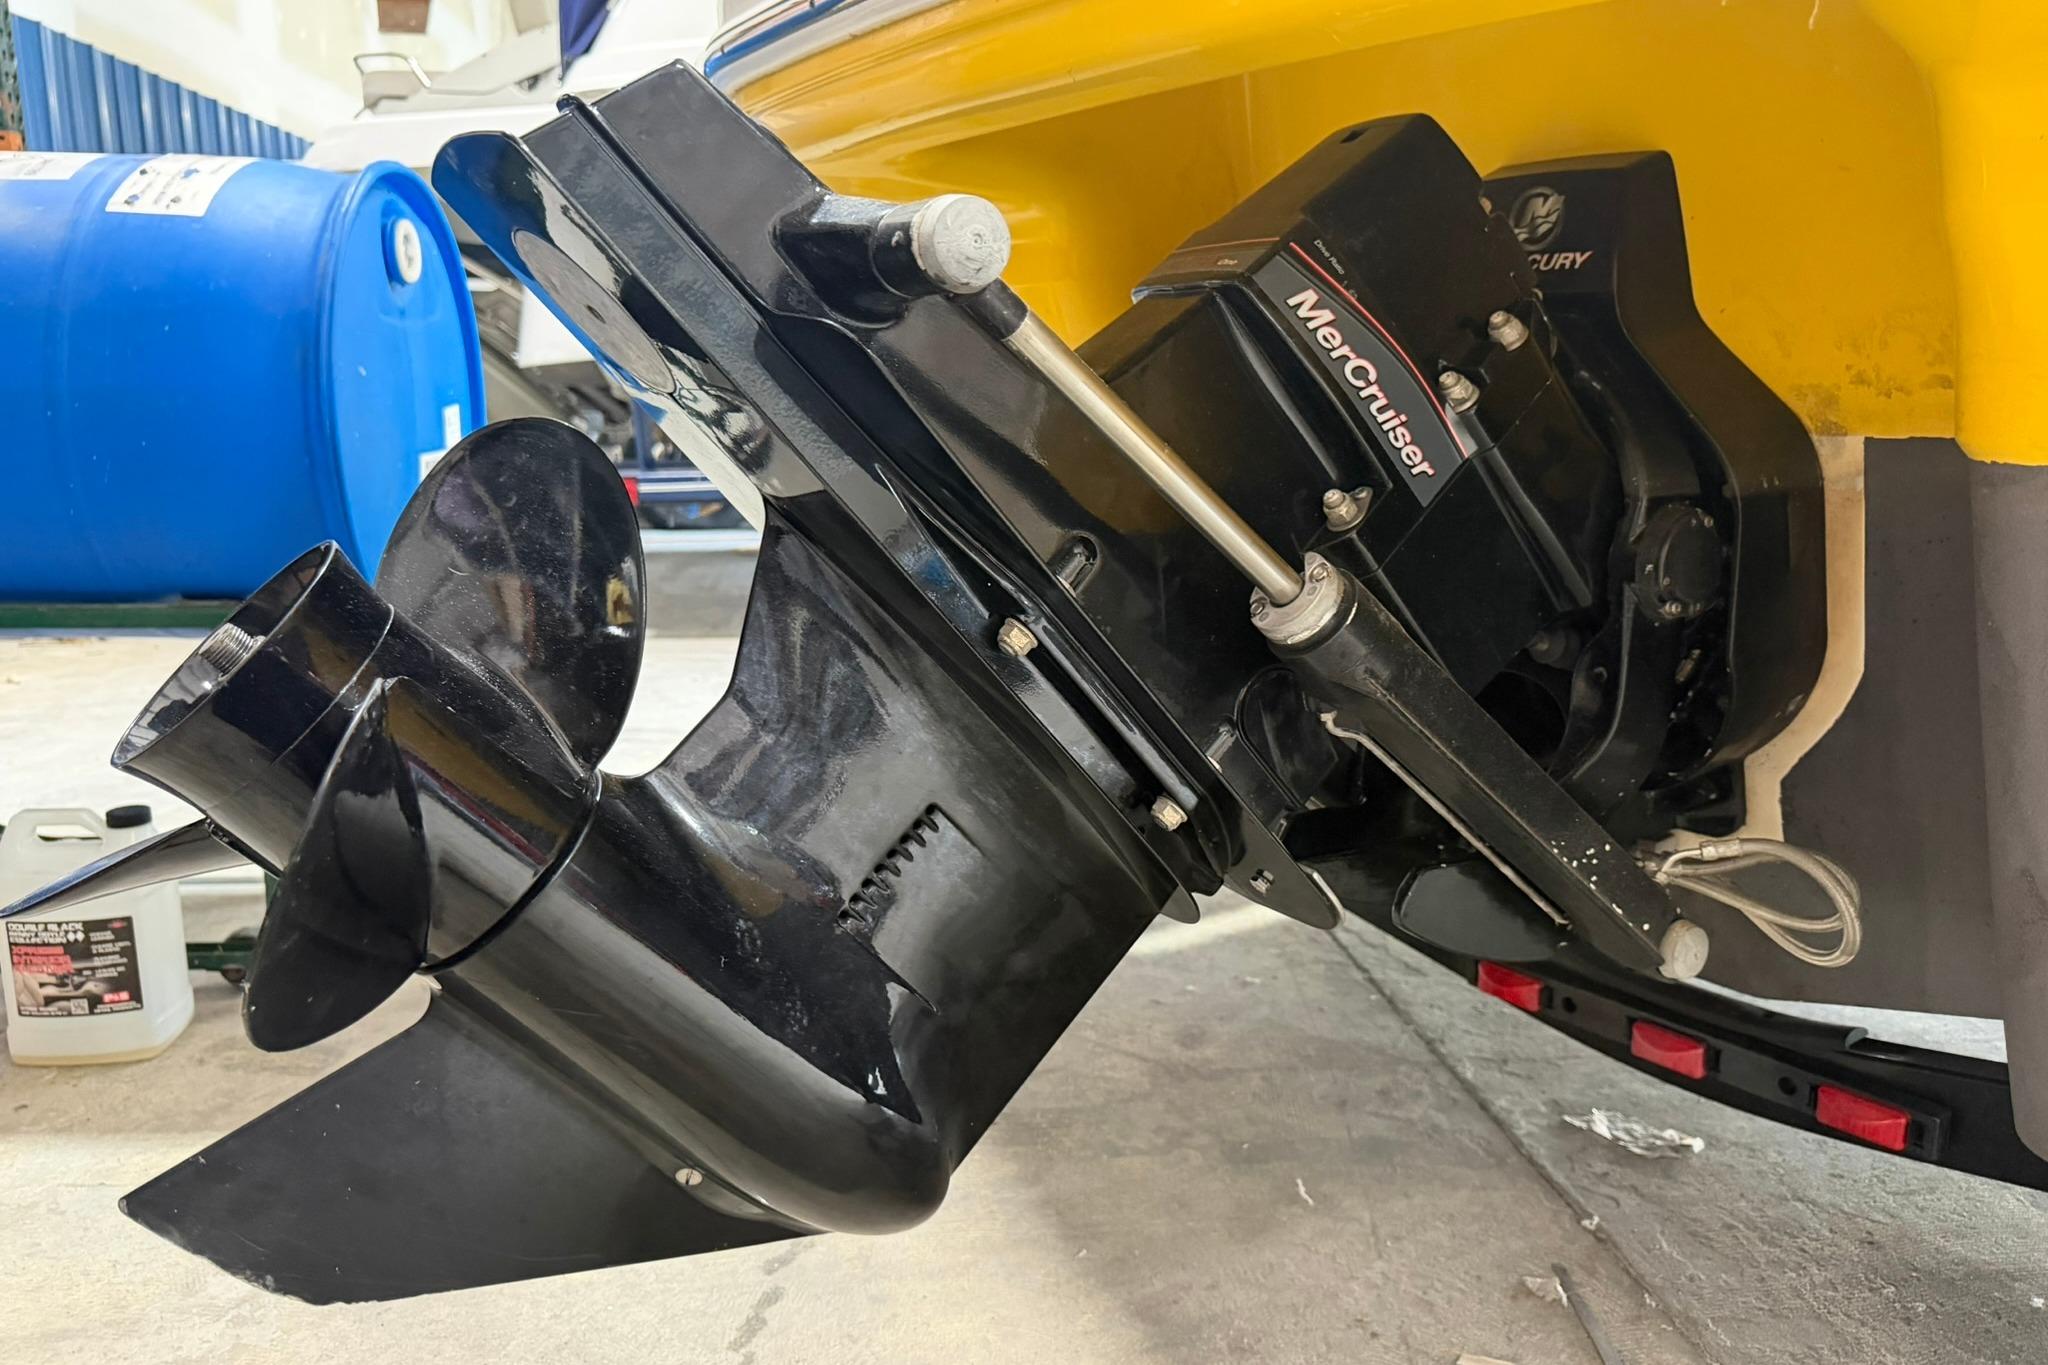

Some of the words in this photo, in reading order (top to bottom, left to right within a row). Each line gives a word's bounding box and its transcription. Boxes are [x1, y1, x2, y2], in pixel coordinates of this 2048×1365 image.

[1527, 250, 1594, 271] CURY
[1286, 288, 1436, 477] MerCruiser
[7, 923, 46, 932] DOUBLE
[46, 922, 85, 931] BLACK
